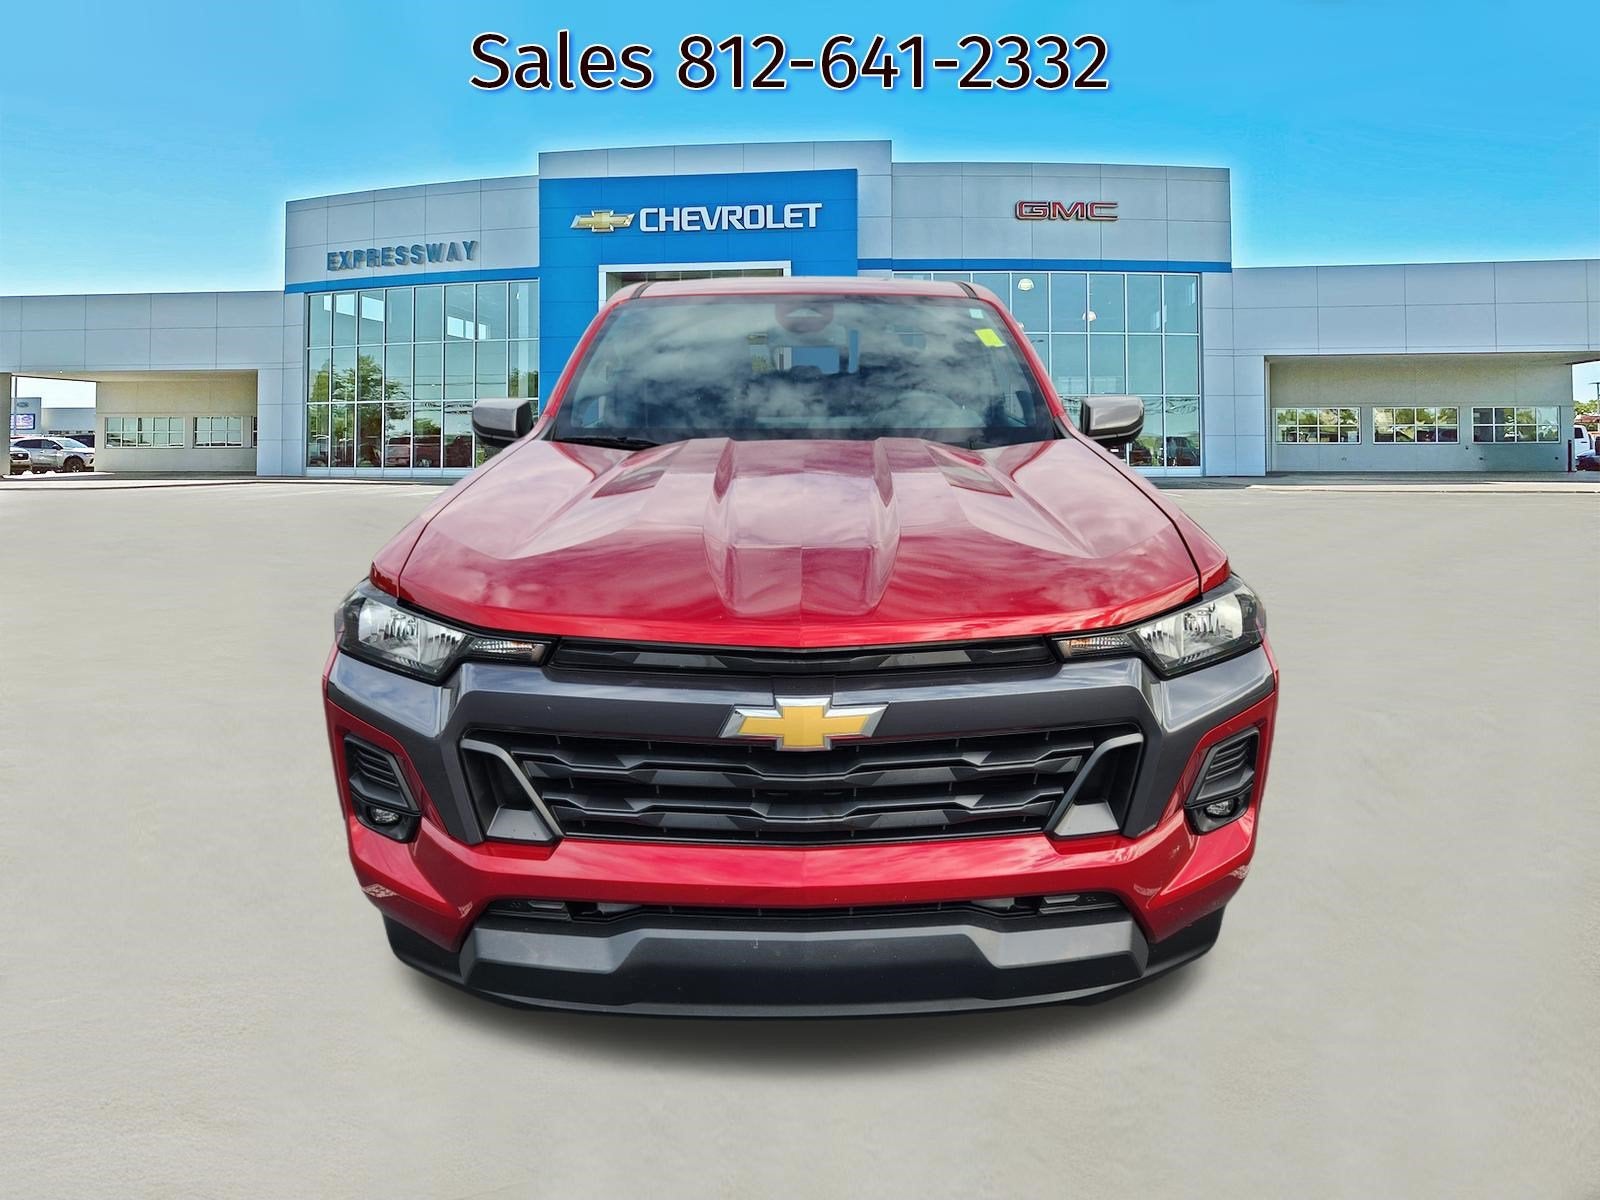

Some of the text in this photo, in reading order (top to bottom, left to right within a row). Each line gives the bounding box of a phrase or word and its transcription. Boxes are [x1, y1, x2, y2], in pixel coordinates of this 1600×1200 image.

[639, 203, 822, 232] CHEVROLET
[1015, 200, 1119, 221] GMC
[327, 240, 478, 271] EXPRESSWAY
